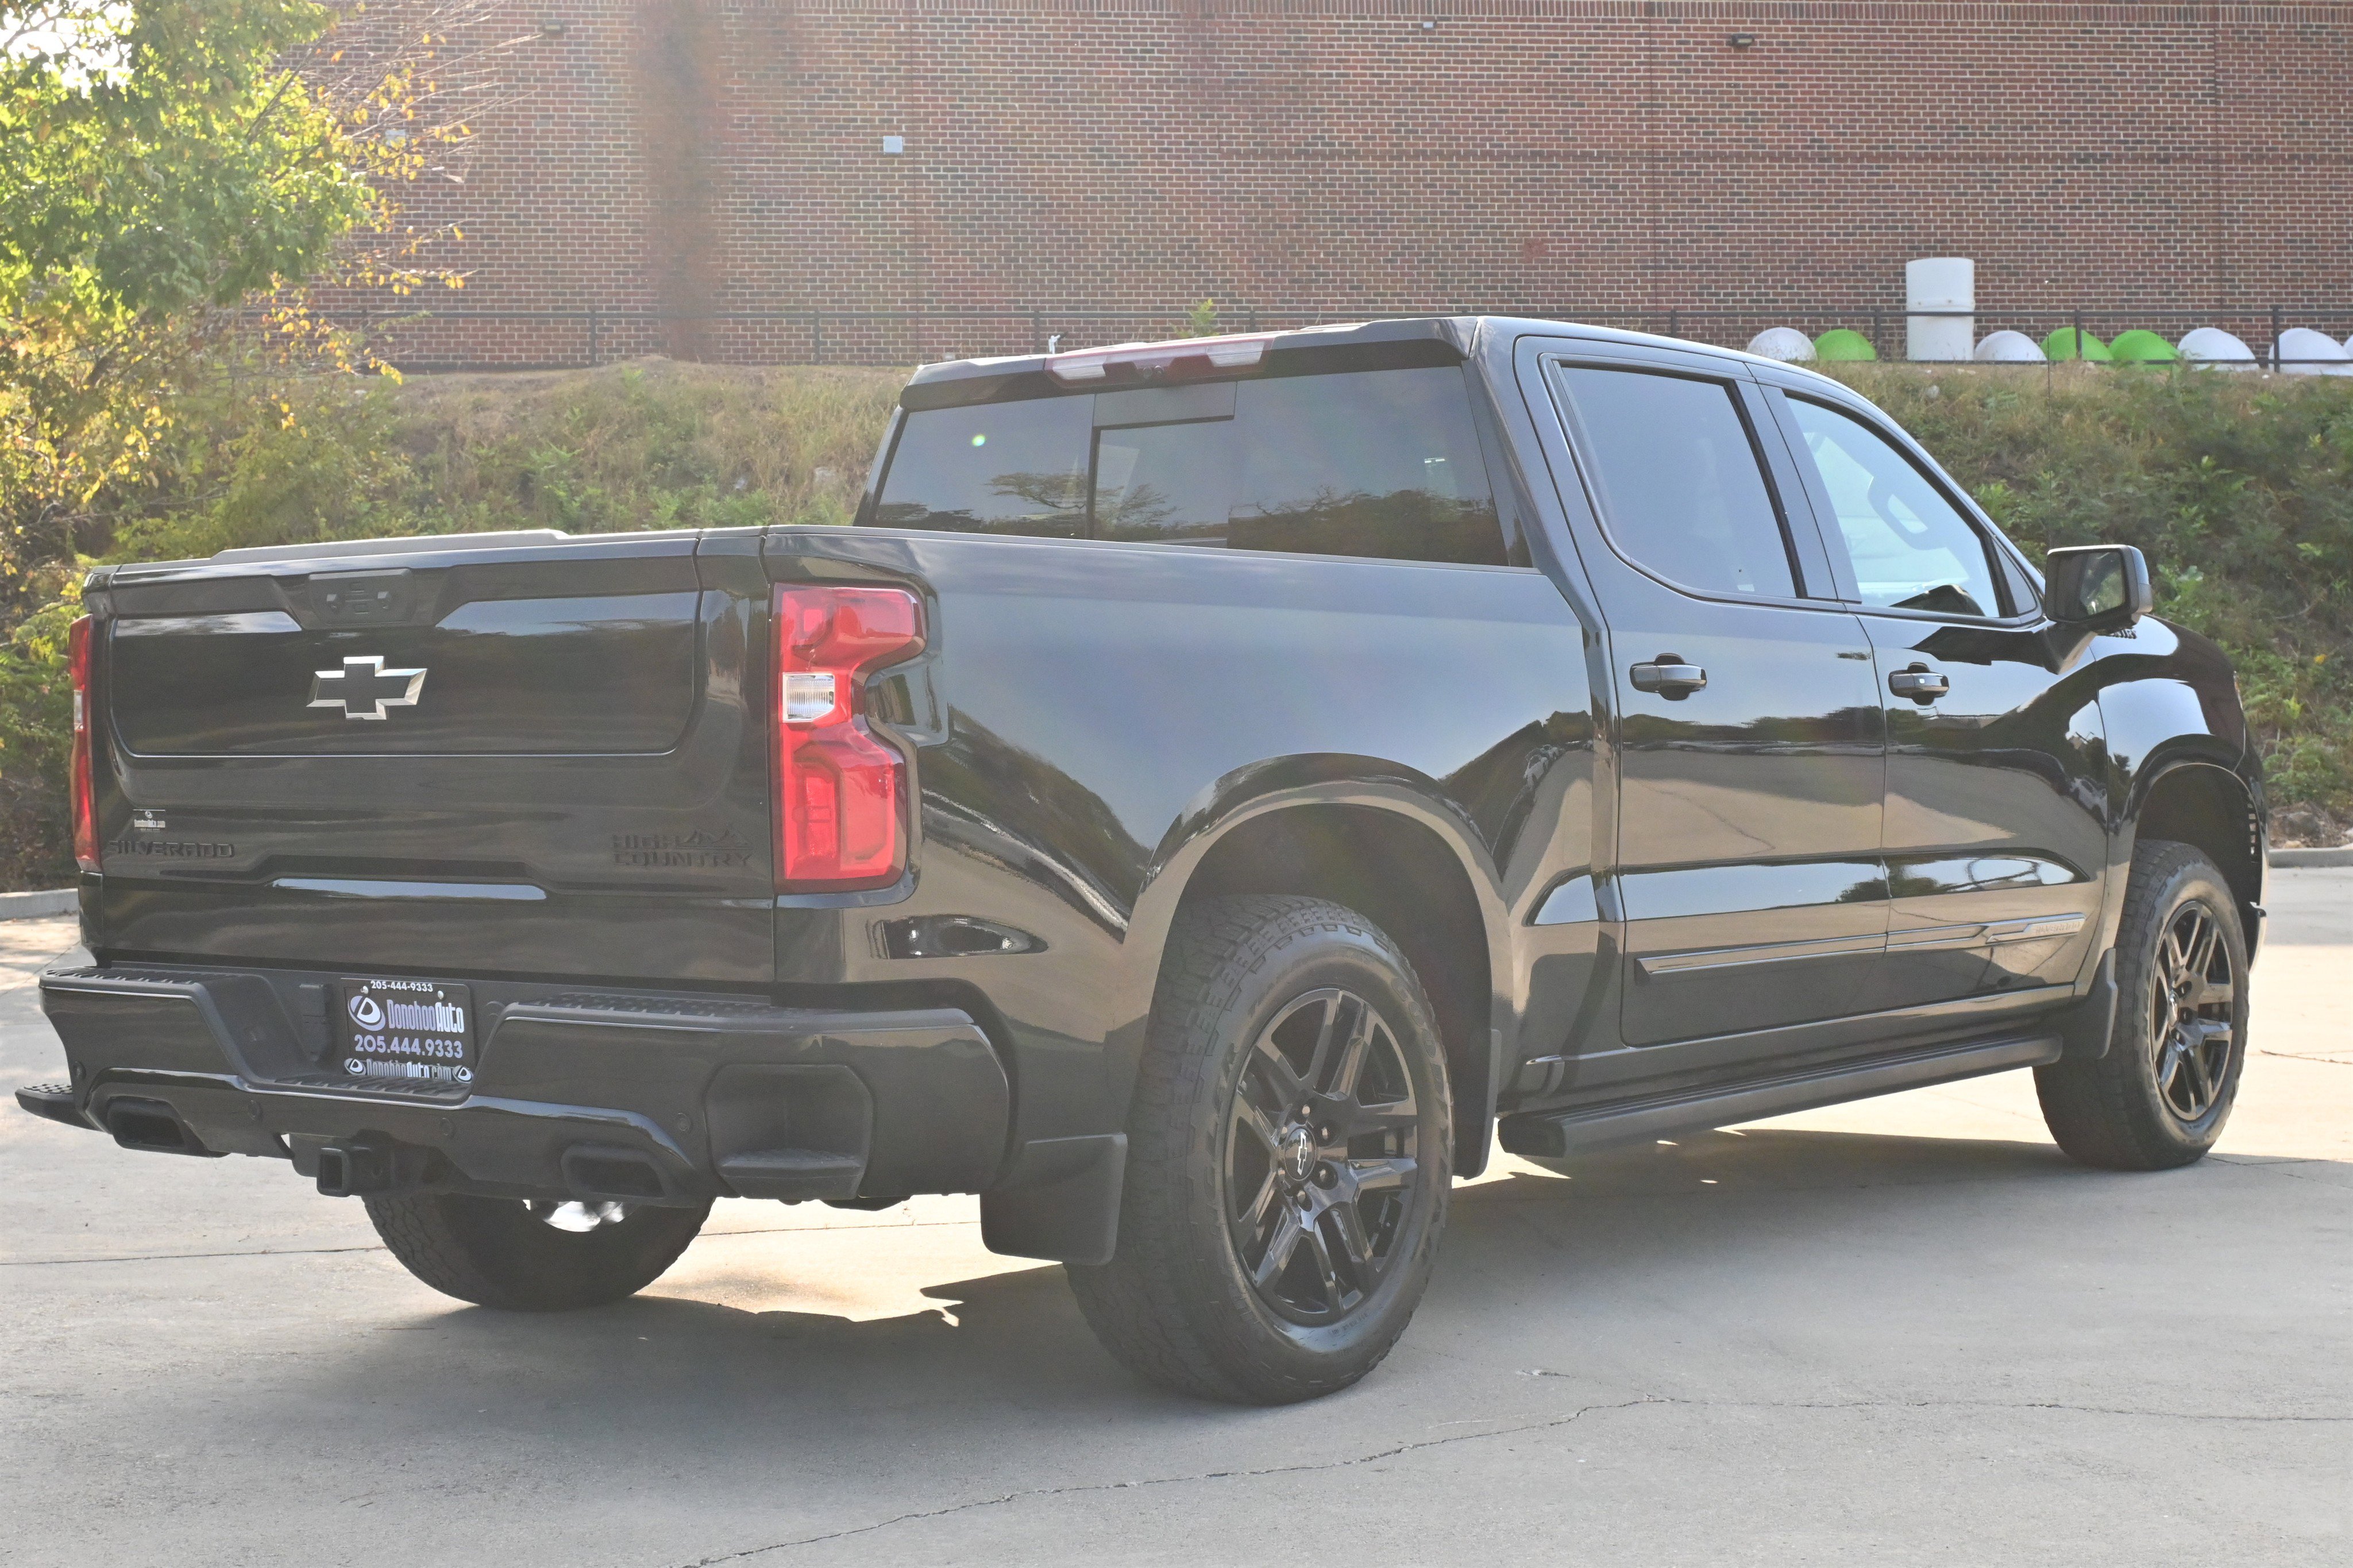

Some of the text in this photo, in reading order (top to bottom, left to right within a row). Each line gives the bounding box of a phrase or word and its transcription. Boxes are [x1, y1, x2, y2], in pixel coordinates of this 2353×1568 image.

[109, 840, 234, 858] SILVERADO
[612, 834, 680, 849] HIGH
[612, 851, 753, 867] COUNTRY
[371, 980, 433, 992] 205-444-9333
[387, 999, 465, 1033] DonohooAuto
[354, 1034, 463, 1059] 205.444.9333
